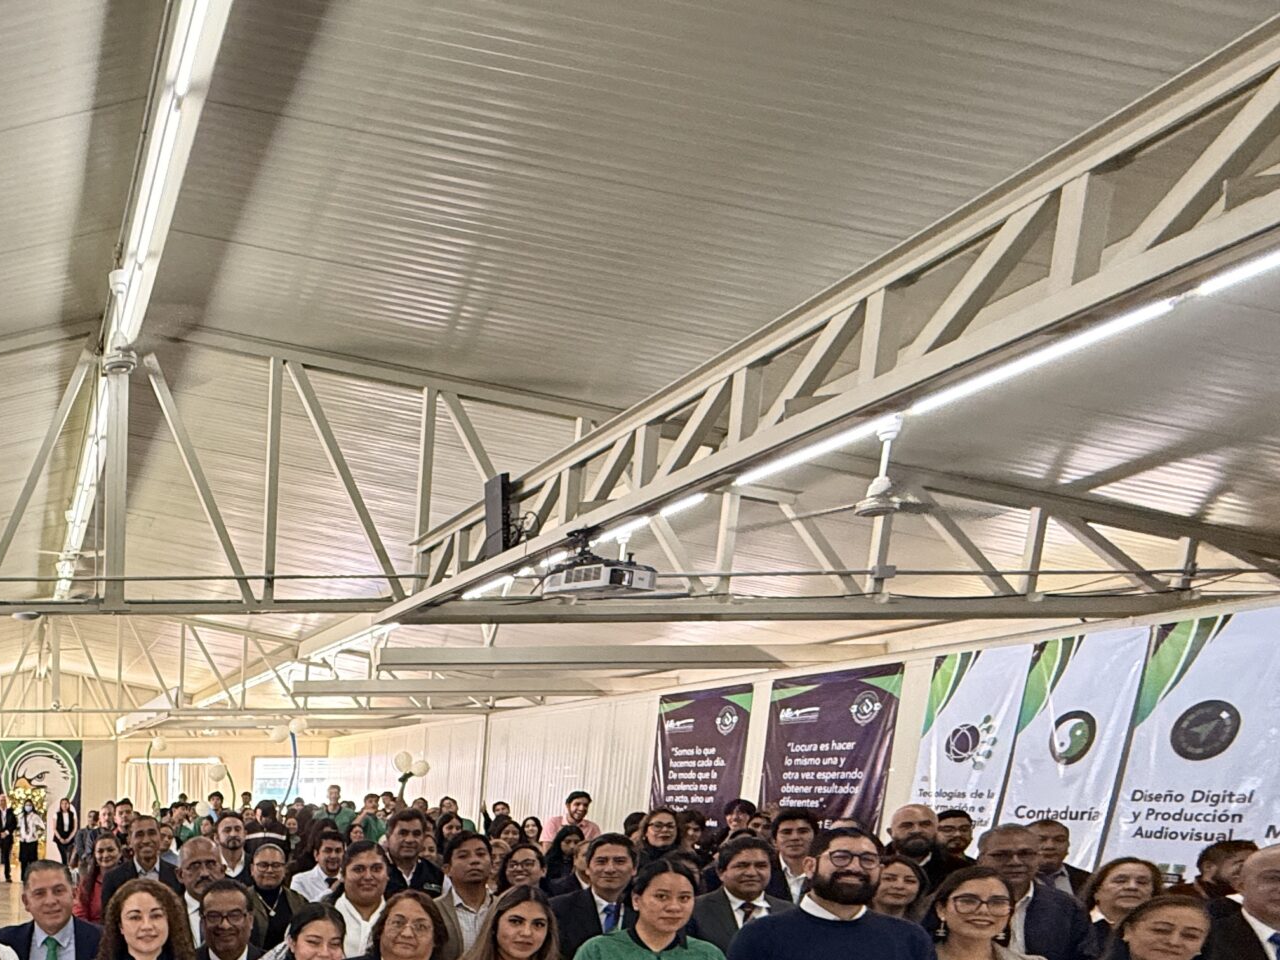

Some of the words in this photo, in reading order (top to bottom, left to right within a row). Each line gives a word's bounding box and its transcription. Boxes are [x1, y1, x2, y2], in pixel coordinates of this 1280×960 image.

[695, 745, 702, 755] lo
[703, 747, 716, 756] que
[819, 743, 829, 751] es
[831, 740, 856, 751] hacer
[669, 758, 696, 768] hacemos
[697, 757, 713, 767] cada
[784, 756, 793, 766] lo
[794, 755, 820, 766] mismo
[822, 757, 838, 765] una
[839, 757, 846, 768] y
[668, 770, 677, 779] De
[678, 769, 696, 779] modo
[697, 771, 710, 781] que
[711, 769, 717, 779] la
[782, 771, 799, 780] otra
[801, 771, 815, 779] vez
[816, 767, 864, 782] esperando
[666, 781, 699, 791] excelencia
[699, 783, 708, 791] no
[708, 783, 717, 791] es
[781, 783, 813, 793] obtener
[814, 782, 859, 794] resultados
[690, 793, 704, 803] sino
[918, 788, 966, 801] Tecologías
[969, 789, 985, 799] de
[1130, 789, 1185, 804] Diseño
[1189, 789, 1255, 808] Digital
[978, 805, 986, 813] e
[1014, 805, 1101, 822] Contaduría
[1130, 810, 1141, 824] y
[1145, 808, 1244, 824] Producción
[1132, 826, 1234, 842] Audiovisual
